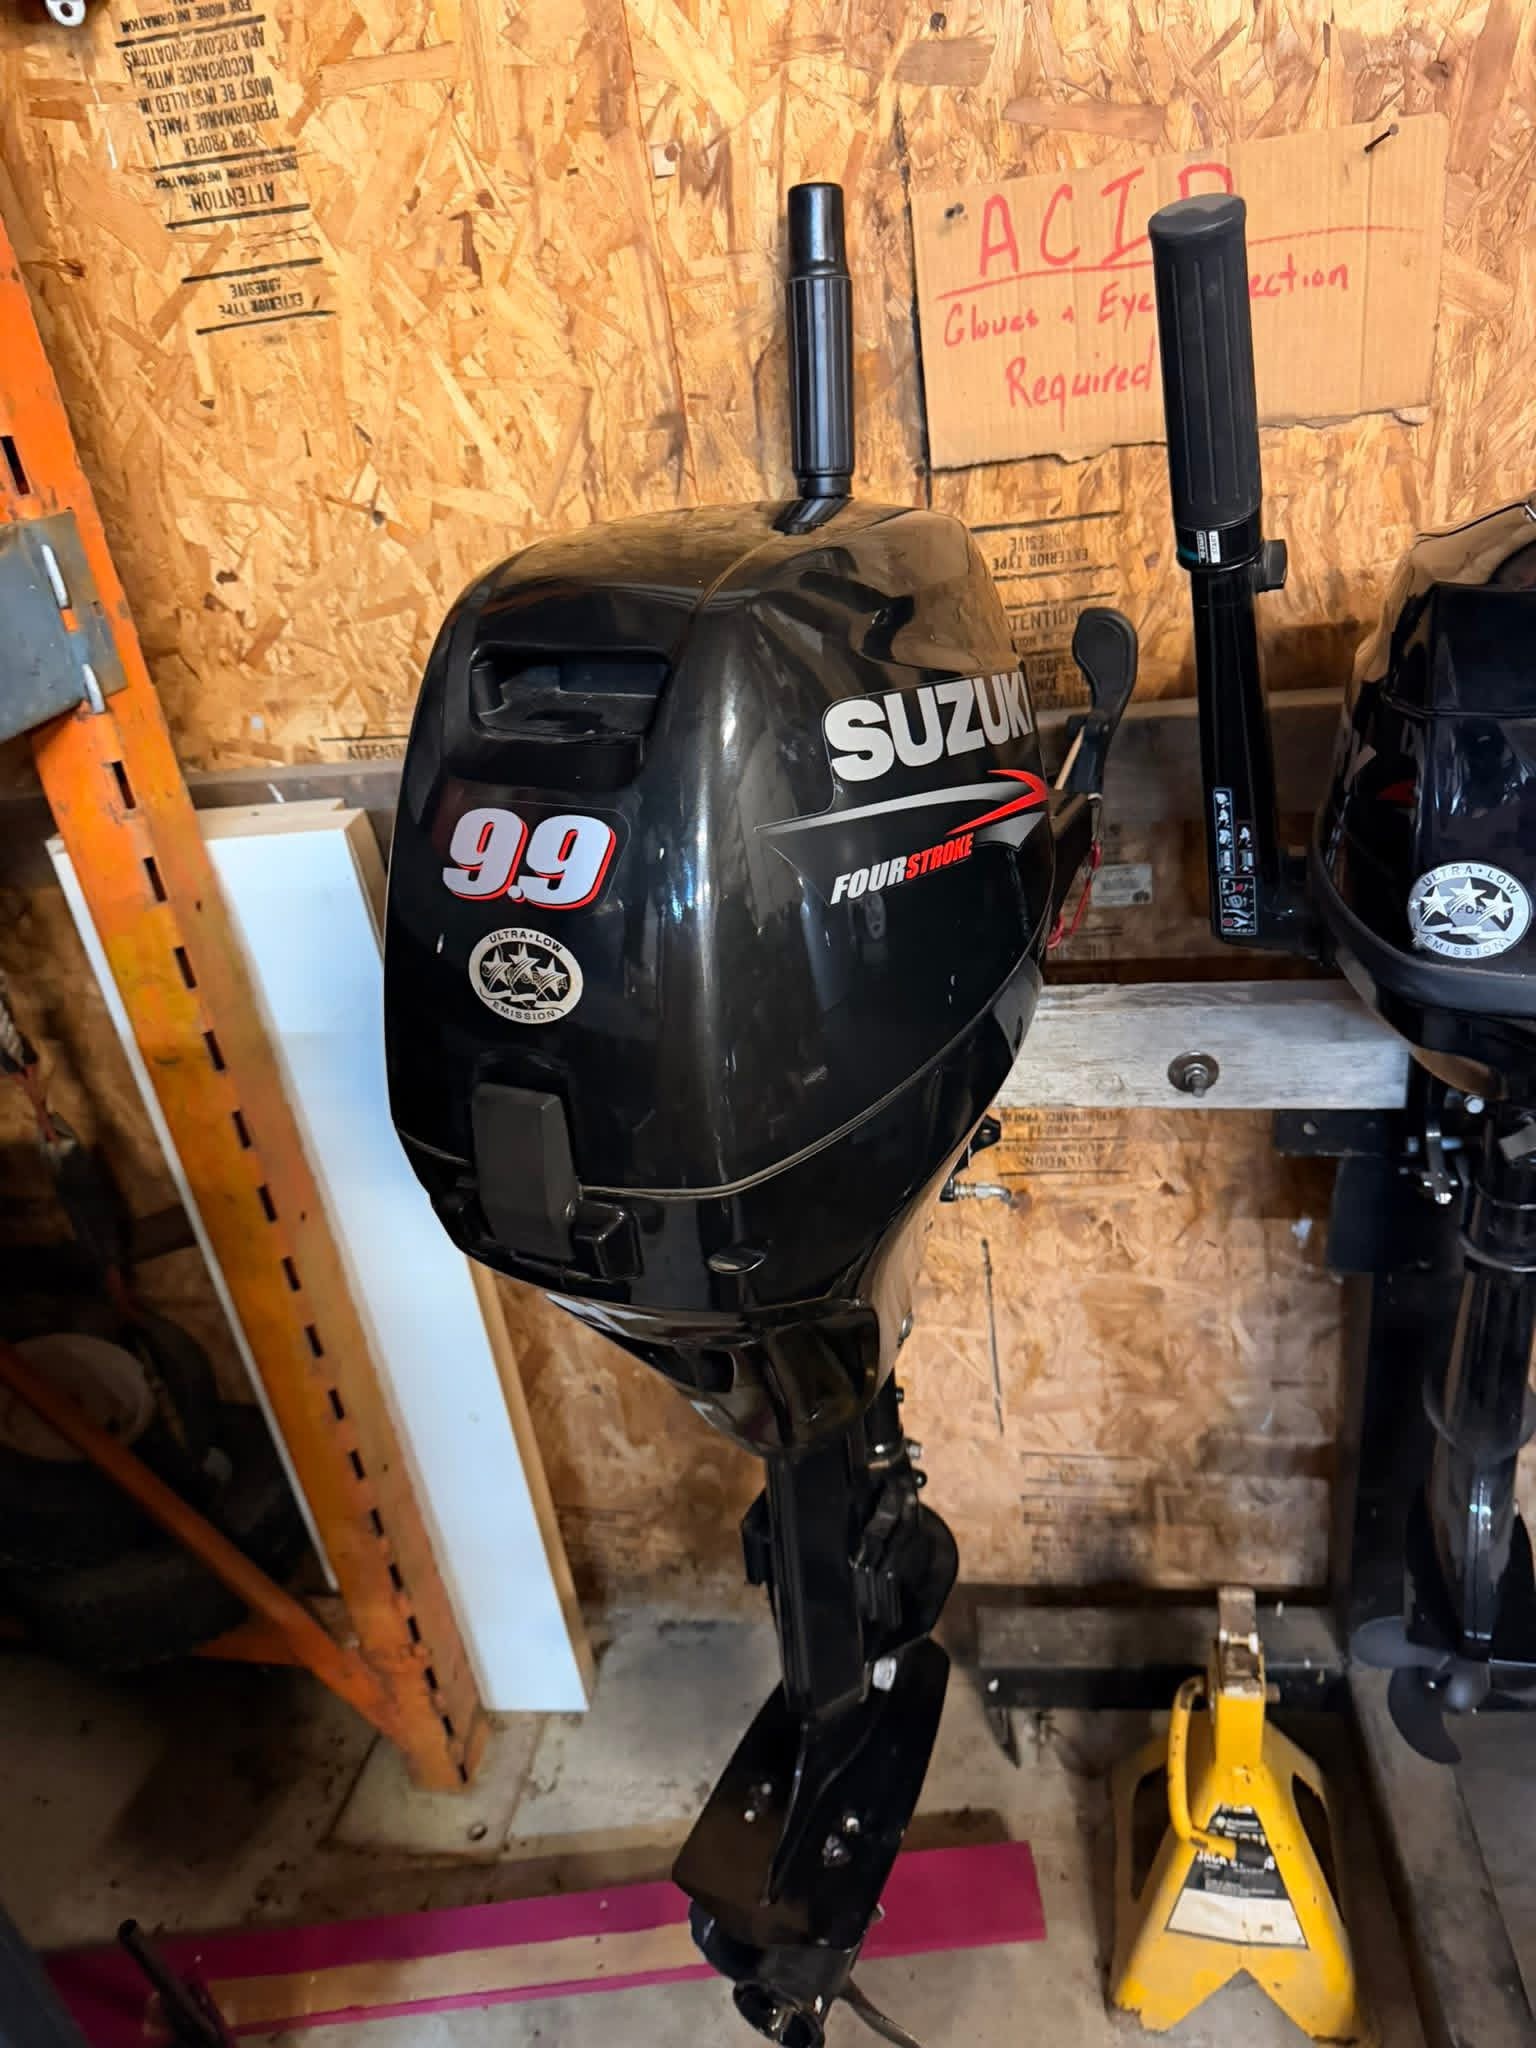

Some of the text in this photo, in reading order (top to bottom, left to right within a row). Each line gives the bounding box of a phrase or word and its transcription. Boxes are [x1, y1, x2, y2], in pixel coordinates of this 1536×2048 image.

[242, 26, 264, 47] APA
[180, 54, 254, 87] ACCORDANCE
[157, 88, 216, 113] INSTALLED
[222, 83, 235, 101] BE
[240, 76, 274, 100] MUST
[146, 100, 280, 137] PERFORMANCE PANELS
[184, 132, 256, 156] FOR PROPER
[218, 292, 304, 319] EXTERIOR TYPE
[1097, 280, 1154, 333] Eye
[1249, 255, 1350, 299] ection
[1005, 334, 1155, 432] Required
[993, 553, 1022, 570] TYPE
[824, 671, 1034, 782] SUZUKI
[442, 807, 617, 911] 9.9
[1422, 865, 1520, 895] ULTRA LOW
[488, 930, 563, 954] ULTRA LOW
[1424, 934, 1505, 957] EMISSION
[492, 1000, 556, 1020] EMISSION
